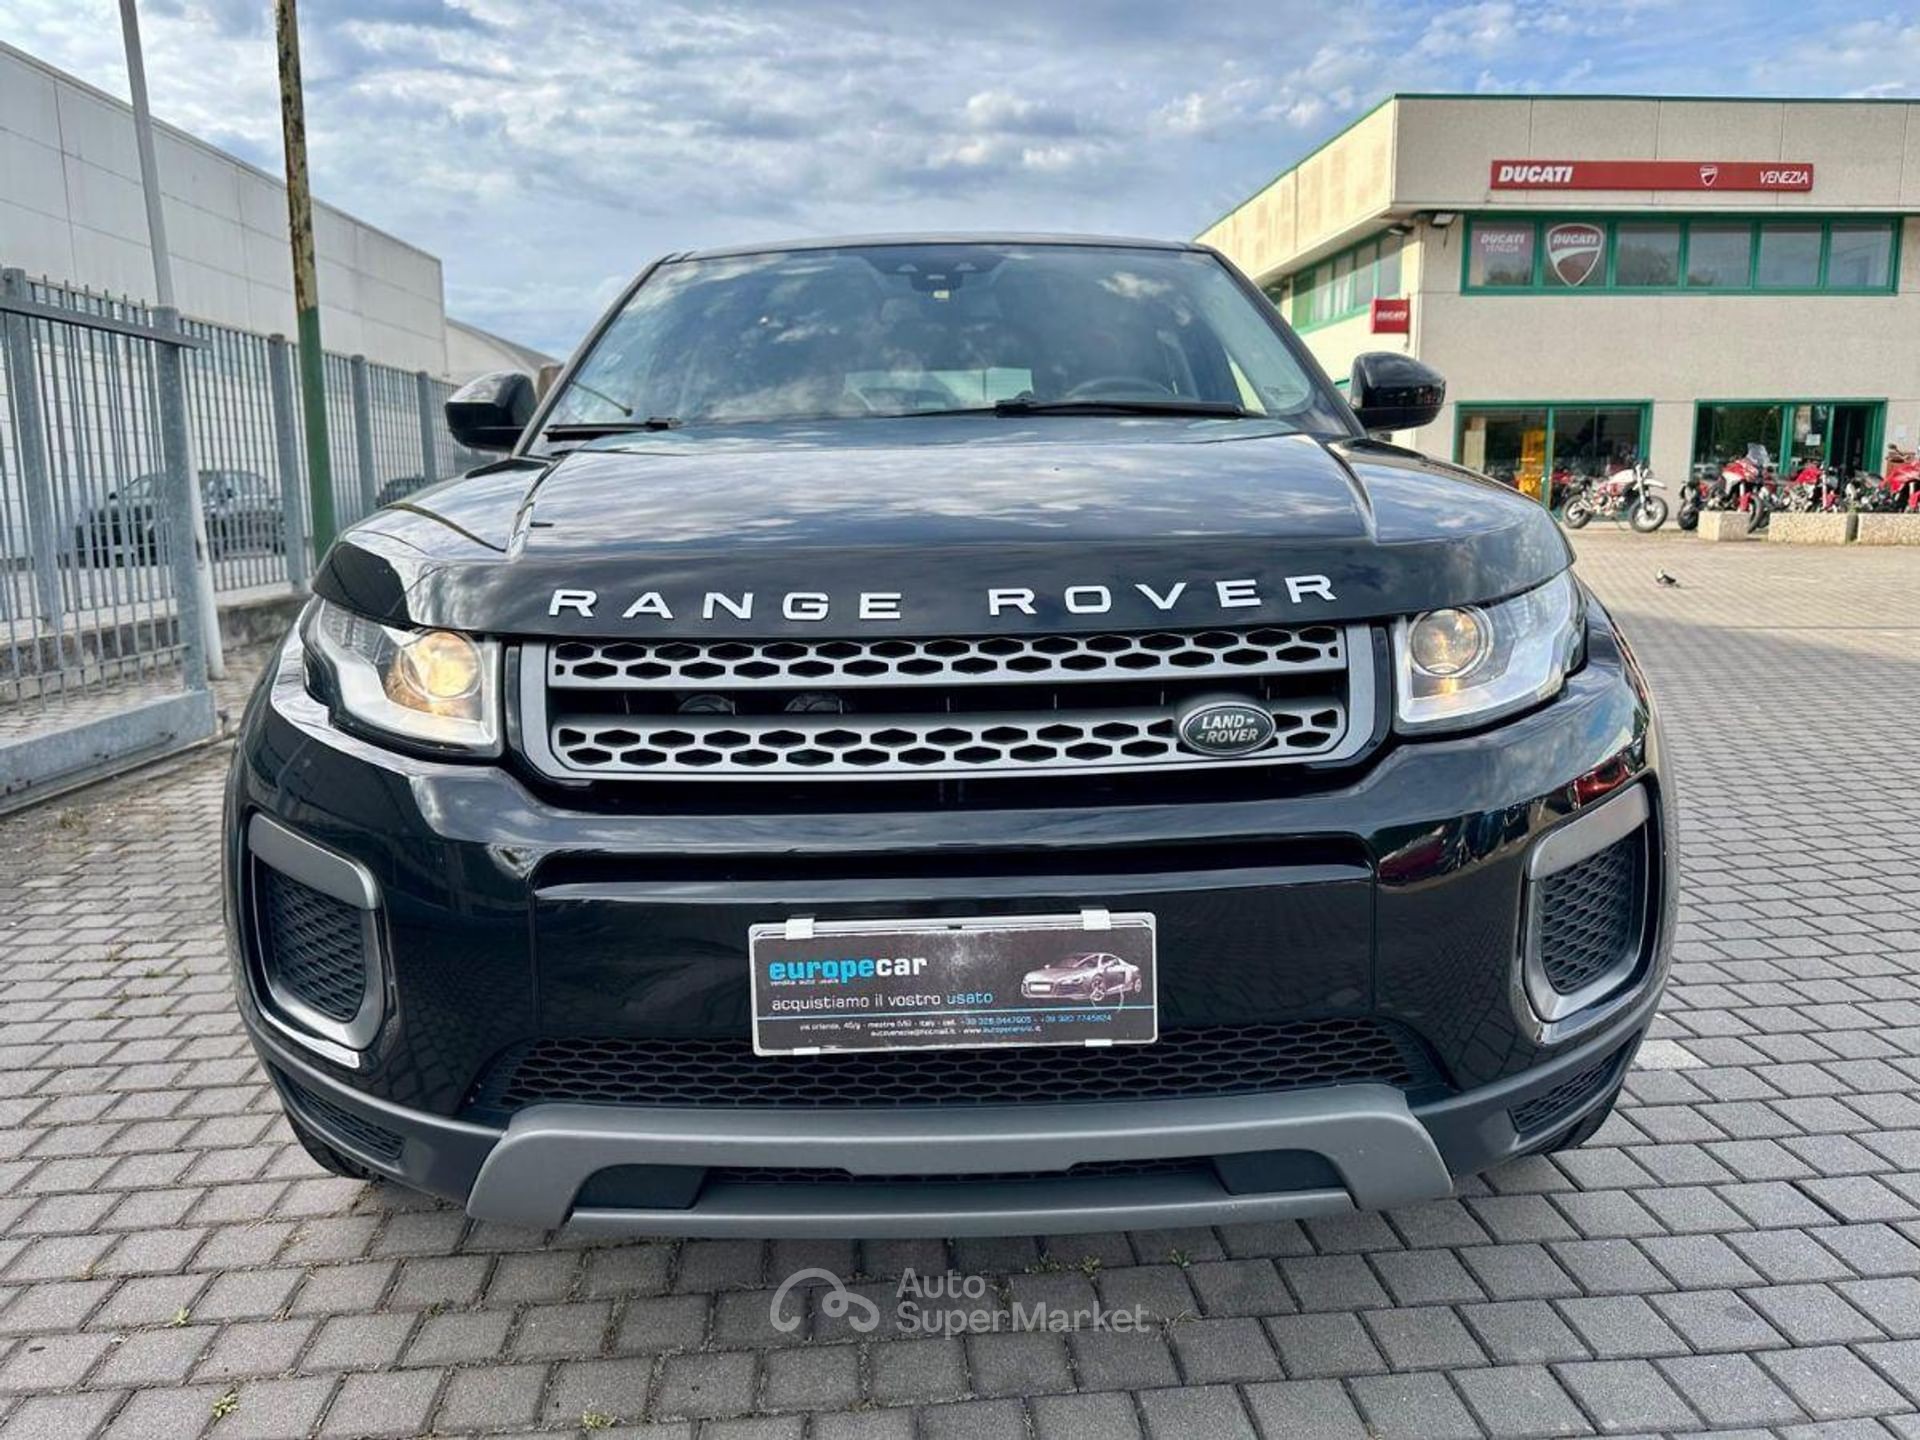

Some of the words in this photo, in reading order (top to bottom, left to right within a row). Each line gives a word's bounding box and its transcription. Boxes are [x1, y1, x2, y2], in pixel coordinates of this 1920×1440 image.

[1498, 165, 1574, 183] DUCATI
[1759, 170, 1809, 184] VENEZIA
[1480, 232, 1525, 244] DUCATI
[1553, 233, 1598, 245] DUCATI
[548, 588, 902, 620] RANGE
[987, 574, 1338, 616] ROVER
[1202, 714, 1245, 729] LAND
[1206, 728, 1259, 743] ROVER
[768, 956, 928, 983] europecar
[771, 995, 870, 1012] acquistiamo
[875, 993, 884, 1007] il
[887, 993, 941, 1007] vostro
[946, 991, 994, 1005] usato
